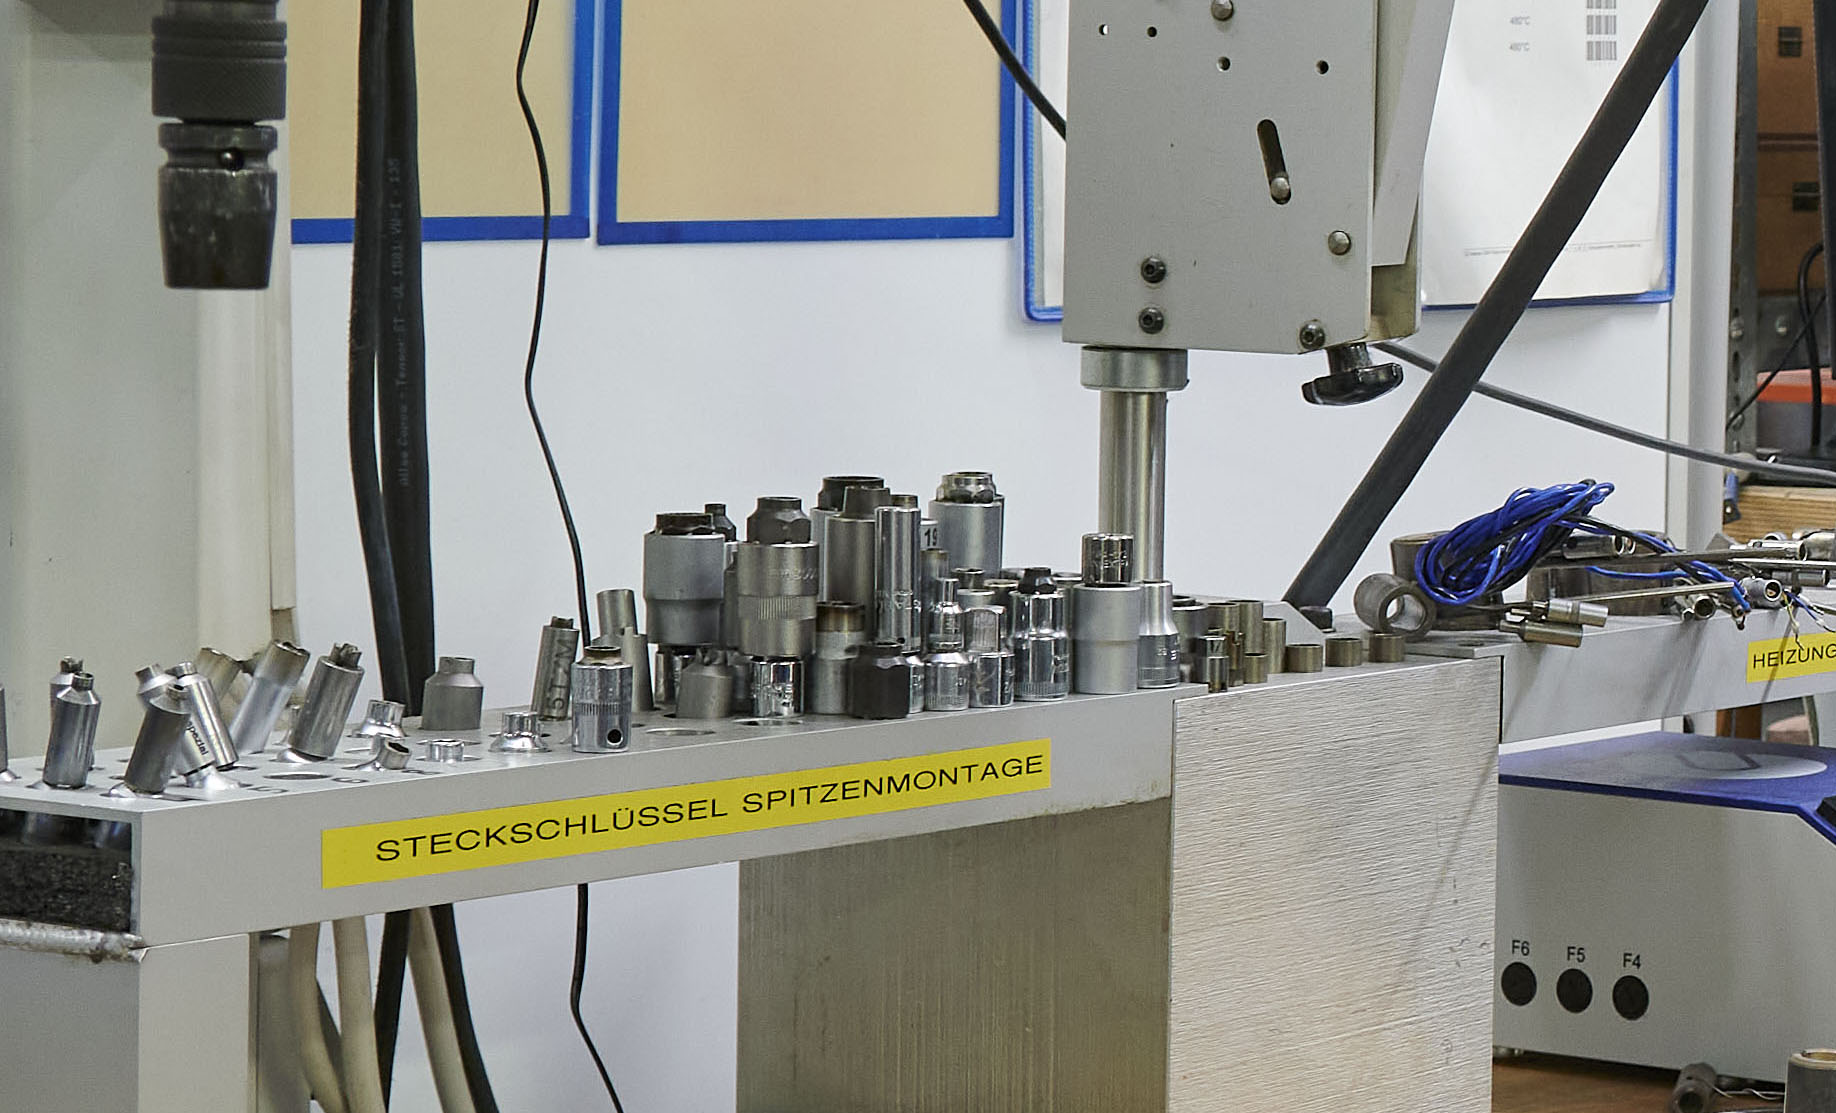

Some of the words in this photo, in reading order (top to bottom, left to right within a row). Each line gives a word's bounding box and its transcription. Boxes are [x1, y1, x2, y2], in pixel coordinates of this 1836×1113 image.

[375, 795, 728, 863] STECKSCHLÜSSEL
[741, 754, 1045, 814] SPITZENMONTAGE
[1512, 940, 1530, 956] F6
[1567, 946, 1586, 963] F5
[1623, 953, 1641, 969] F4
